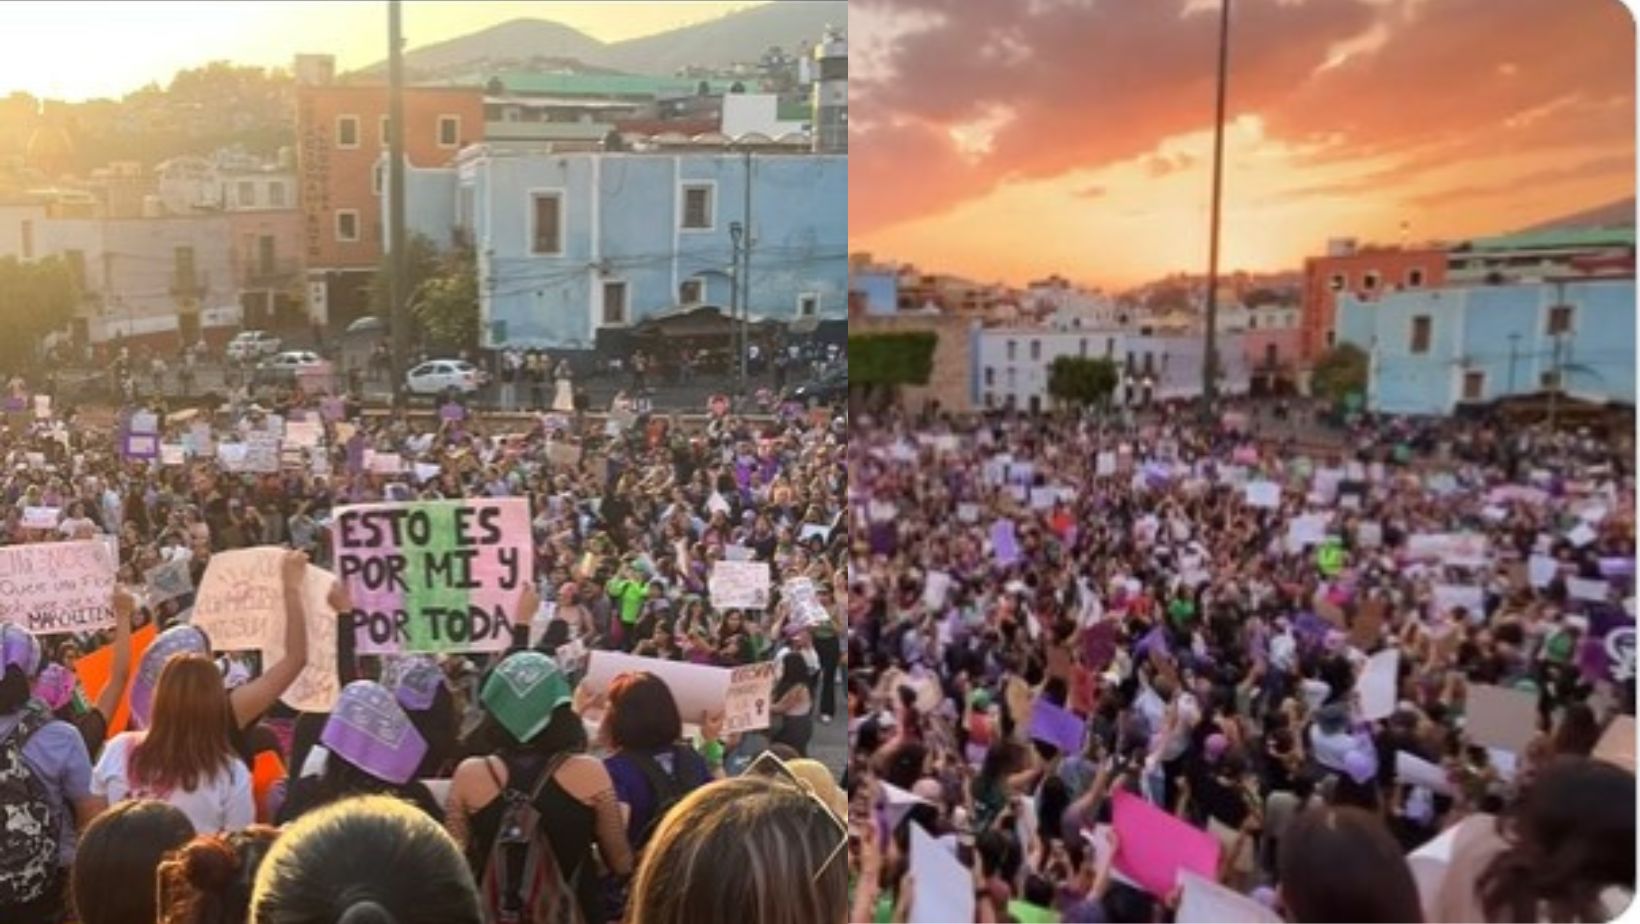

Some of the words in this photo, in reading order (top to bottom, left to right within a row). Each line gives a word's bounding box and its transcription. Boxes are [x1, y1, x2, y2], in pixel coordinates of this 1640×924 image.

[340, 509, 431, 547] ESTO
[454, 507, 501, 545] ES
[339, 555, 411, 592] POR
[425, 549, 482, 589] MI
[351, 608, 411, 644] POR
